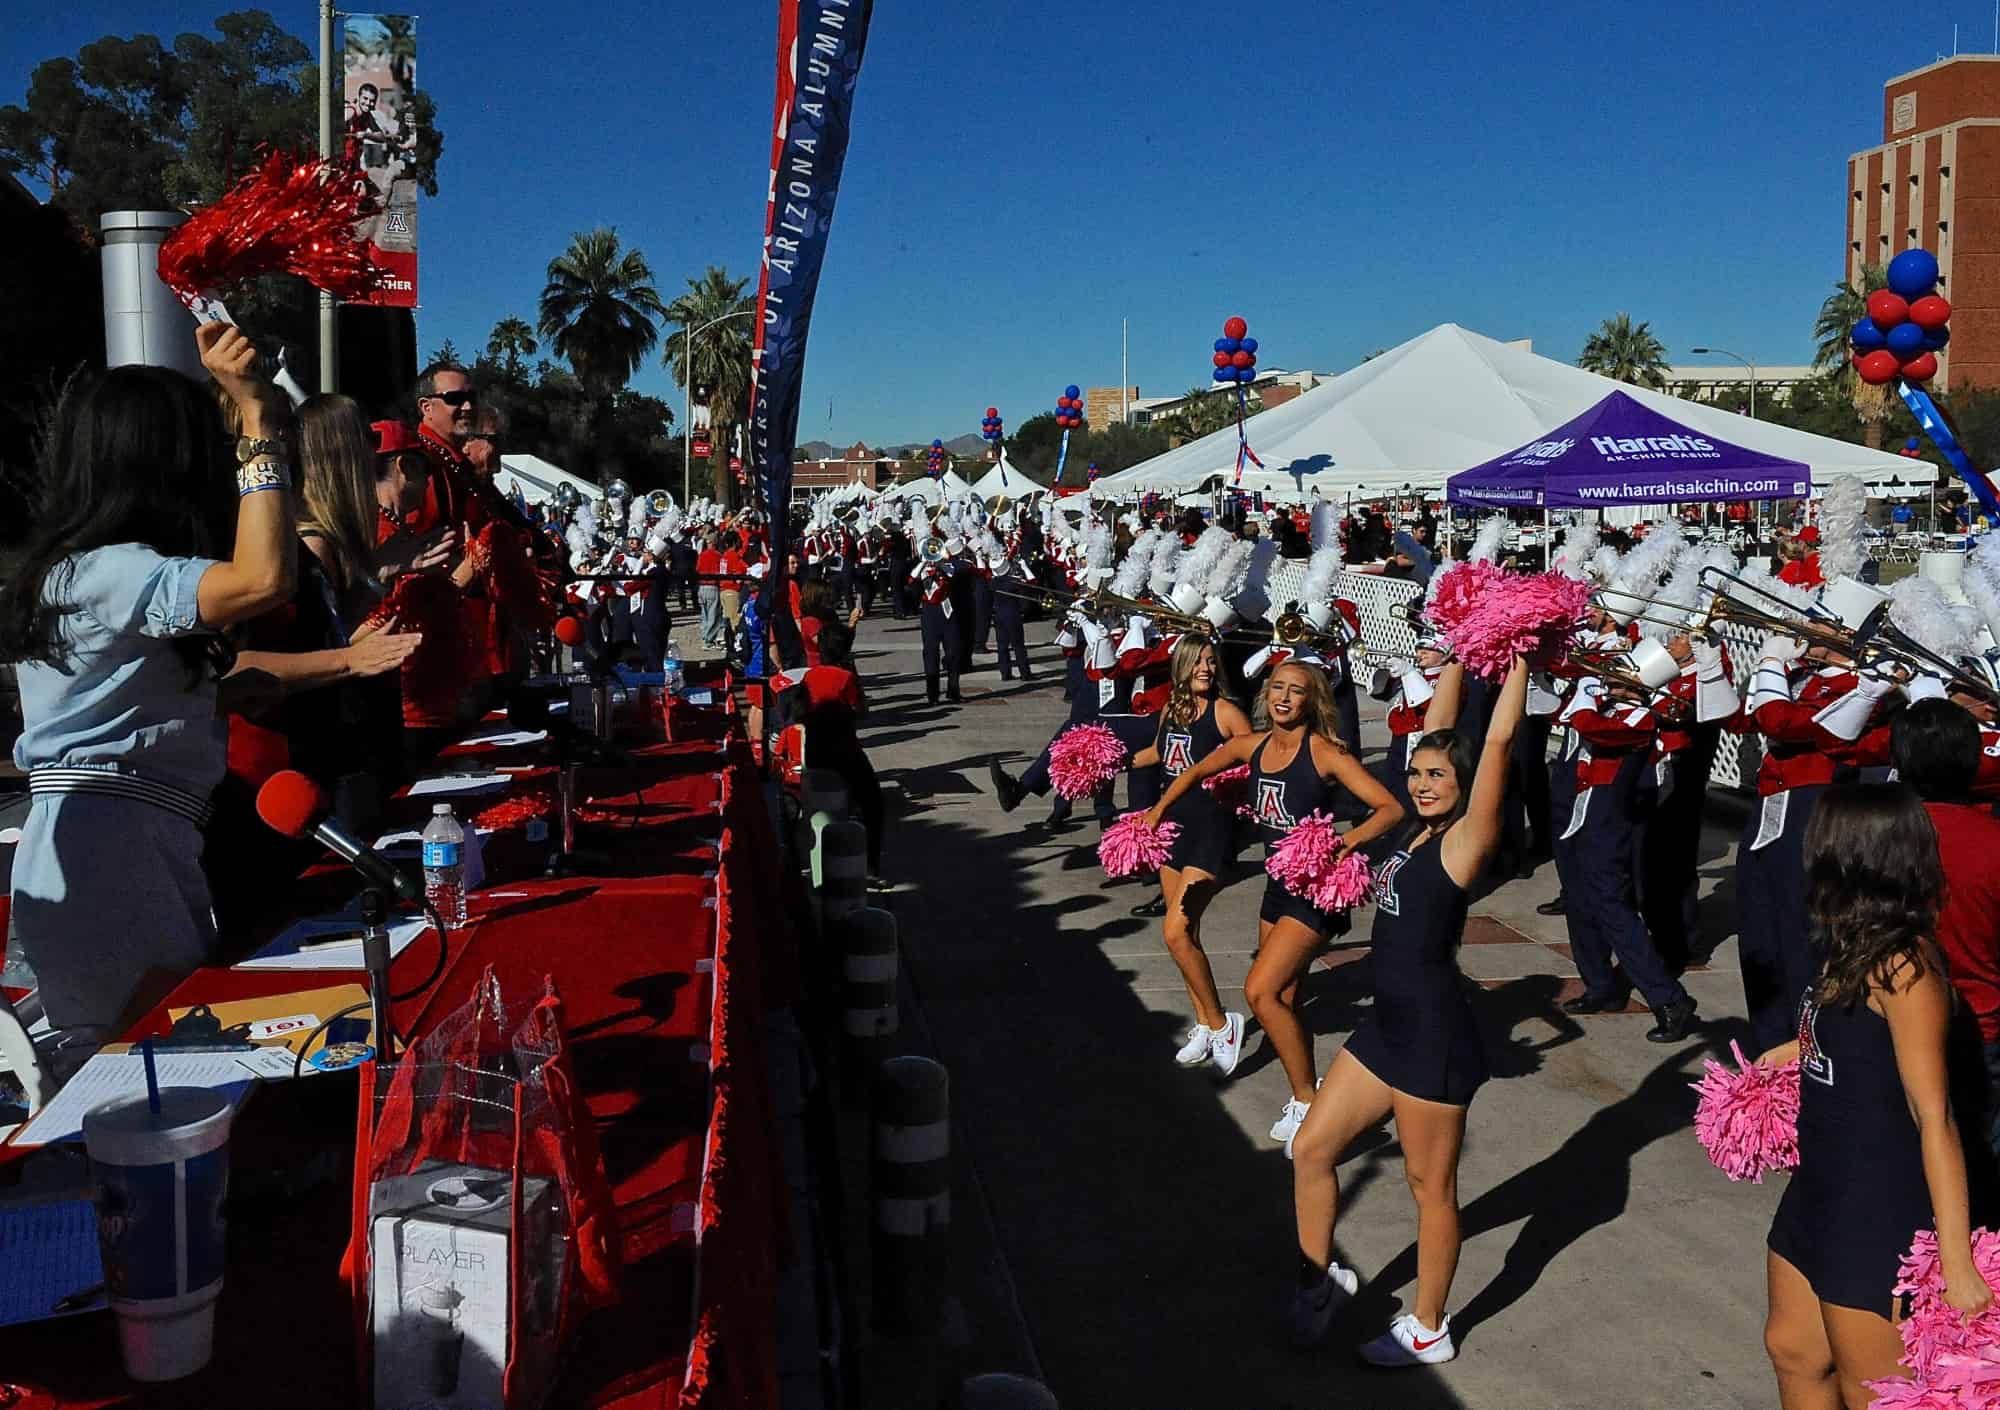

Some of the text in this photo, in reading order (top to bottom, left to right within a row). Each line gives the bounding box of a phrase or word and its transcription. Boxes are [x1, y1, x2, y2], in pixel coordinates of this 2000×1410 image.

[771, 139, 817, 275] ARIZONA
[801, 0, 849, 118] ALUMNI
[385, 211, 409, 233] A
[1590, 434, 1714, 455] Harrah's
[1578, 478, 1779, 499] www.harrahsakchin.com
[1164, 733, 1195, 776] A
[1256, 778, 1297, 831] A
[402, 1245, 486, 1271] PLAYER
